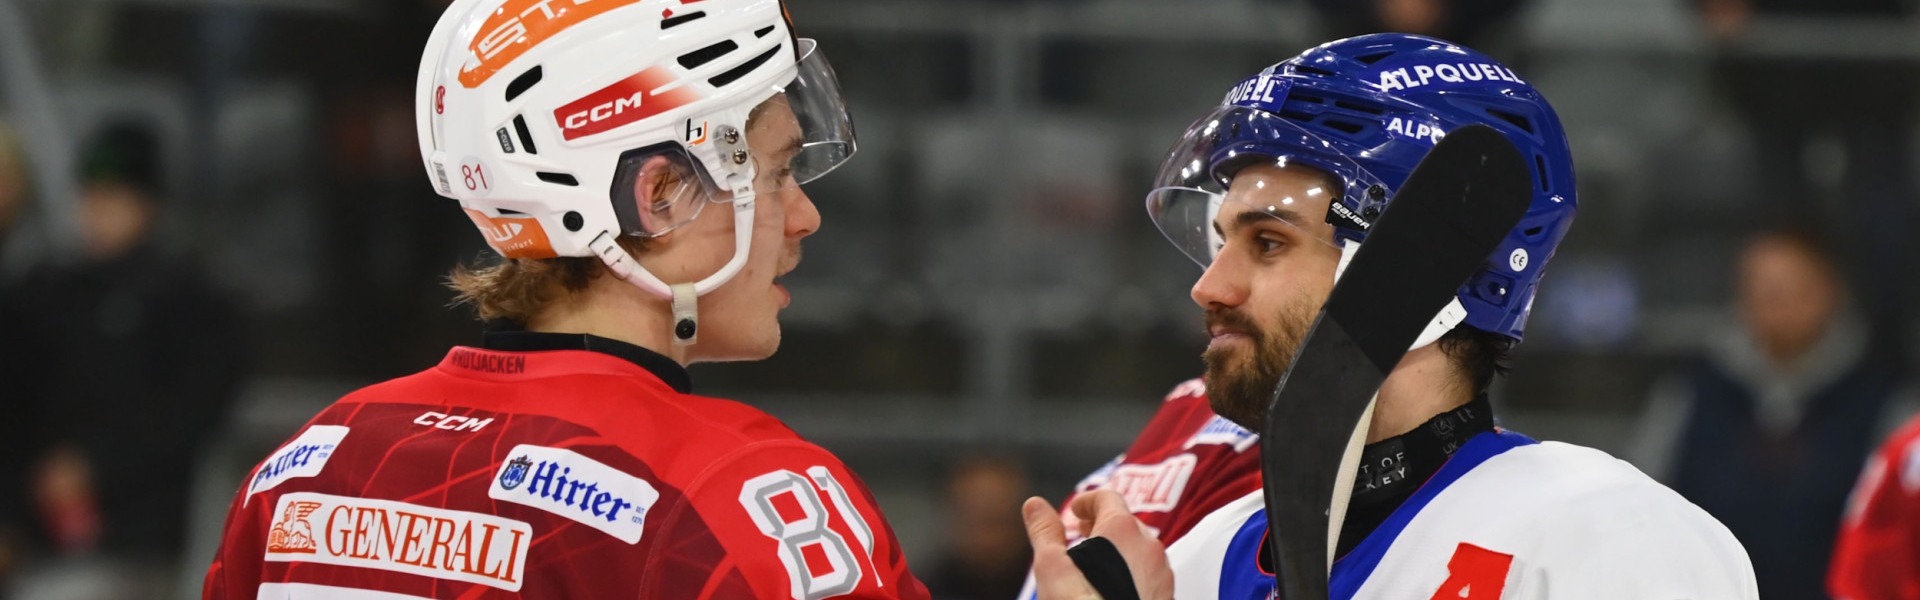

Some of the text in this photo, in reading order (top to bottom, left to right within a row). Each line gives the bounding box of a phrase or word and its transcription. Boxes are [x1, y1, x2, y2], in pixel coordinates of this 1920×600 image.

[1380, 63, 1526, 93] ALPQUELL
[565, 91, 642, 129] CCM
[461, 163, 488, 191] 81
[413, 411, 495, 432] CCM
[527, 460, 631, 522] Hirter
[325, 504, 525, 583] GENERALI
[738, 465, 883, 600] 81
